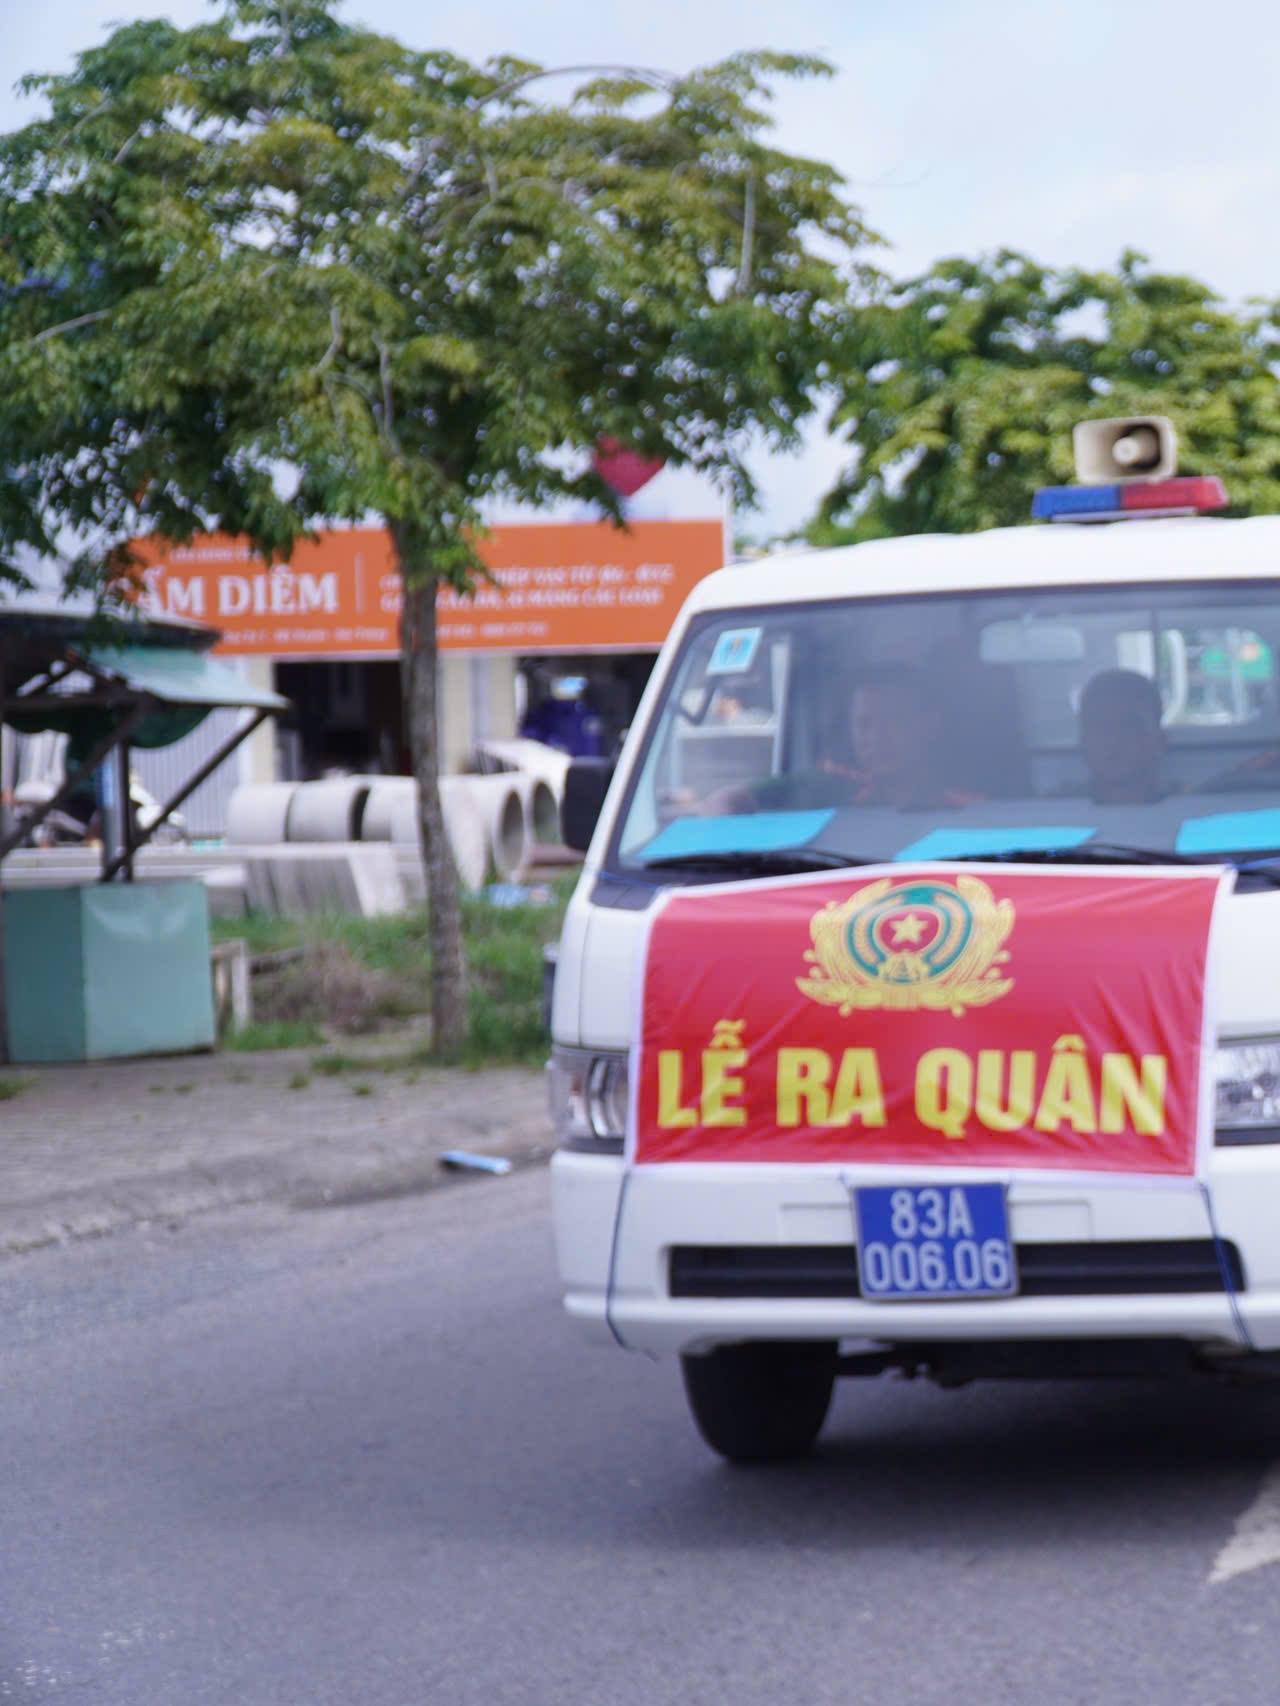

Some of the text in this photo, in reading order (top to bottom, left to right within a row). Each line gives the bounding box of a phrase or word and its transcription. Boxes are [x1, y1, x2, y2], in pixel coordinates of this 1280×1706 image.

[657, 1019, 1167, 1139] LỄ RA QUÂN
[890, 1187, 975, 1239] 83A
[864, 1238, 1010, 1292] 006.06
